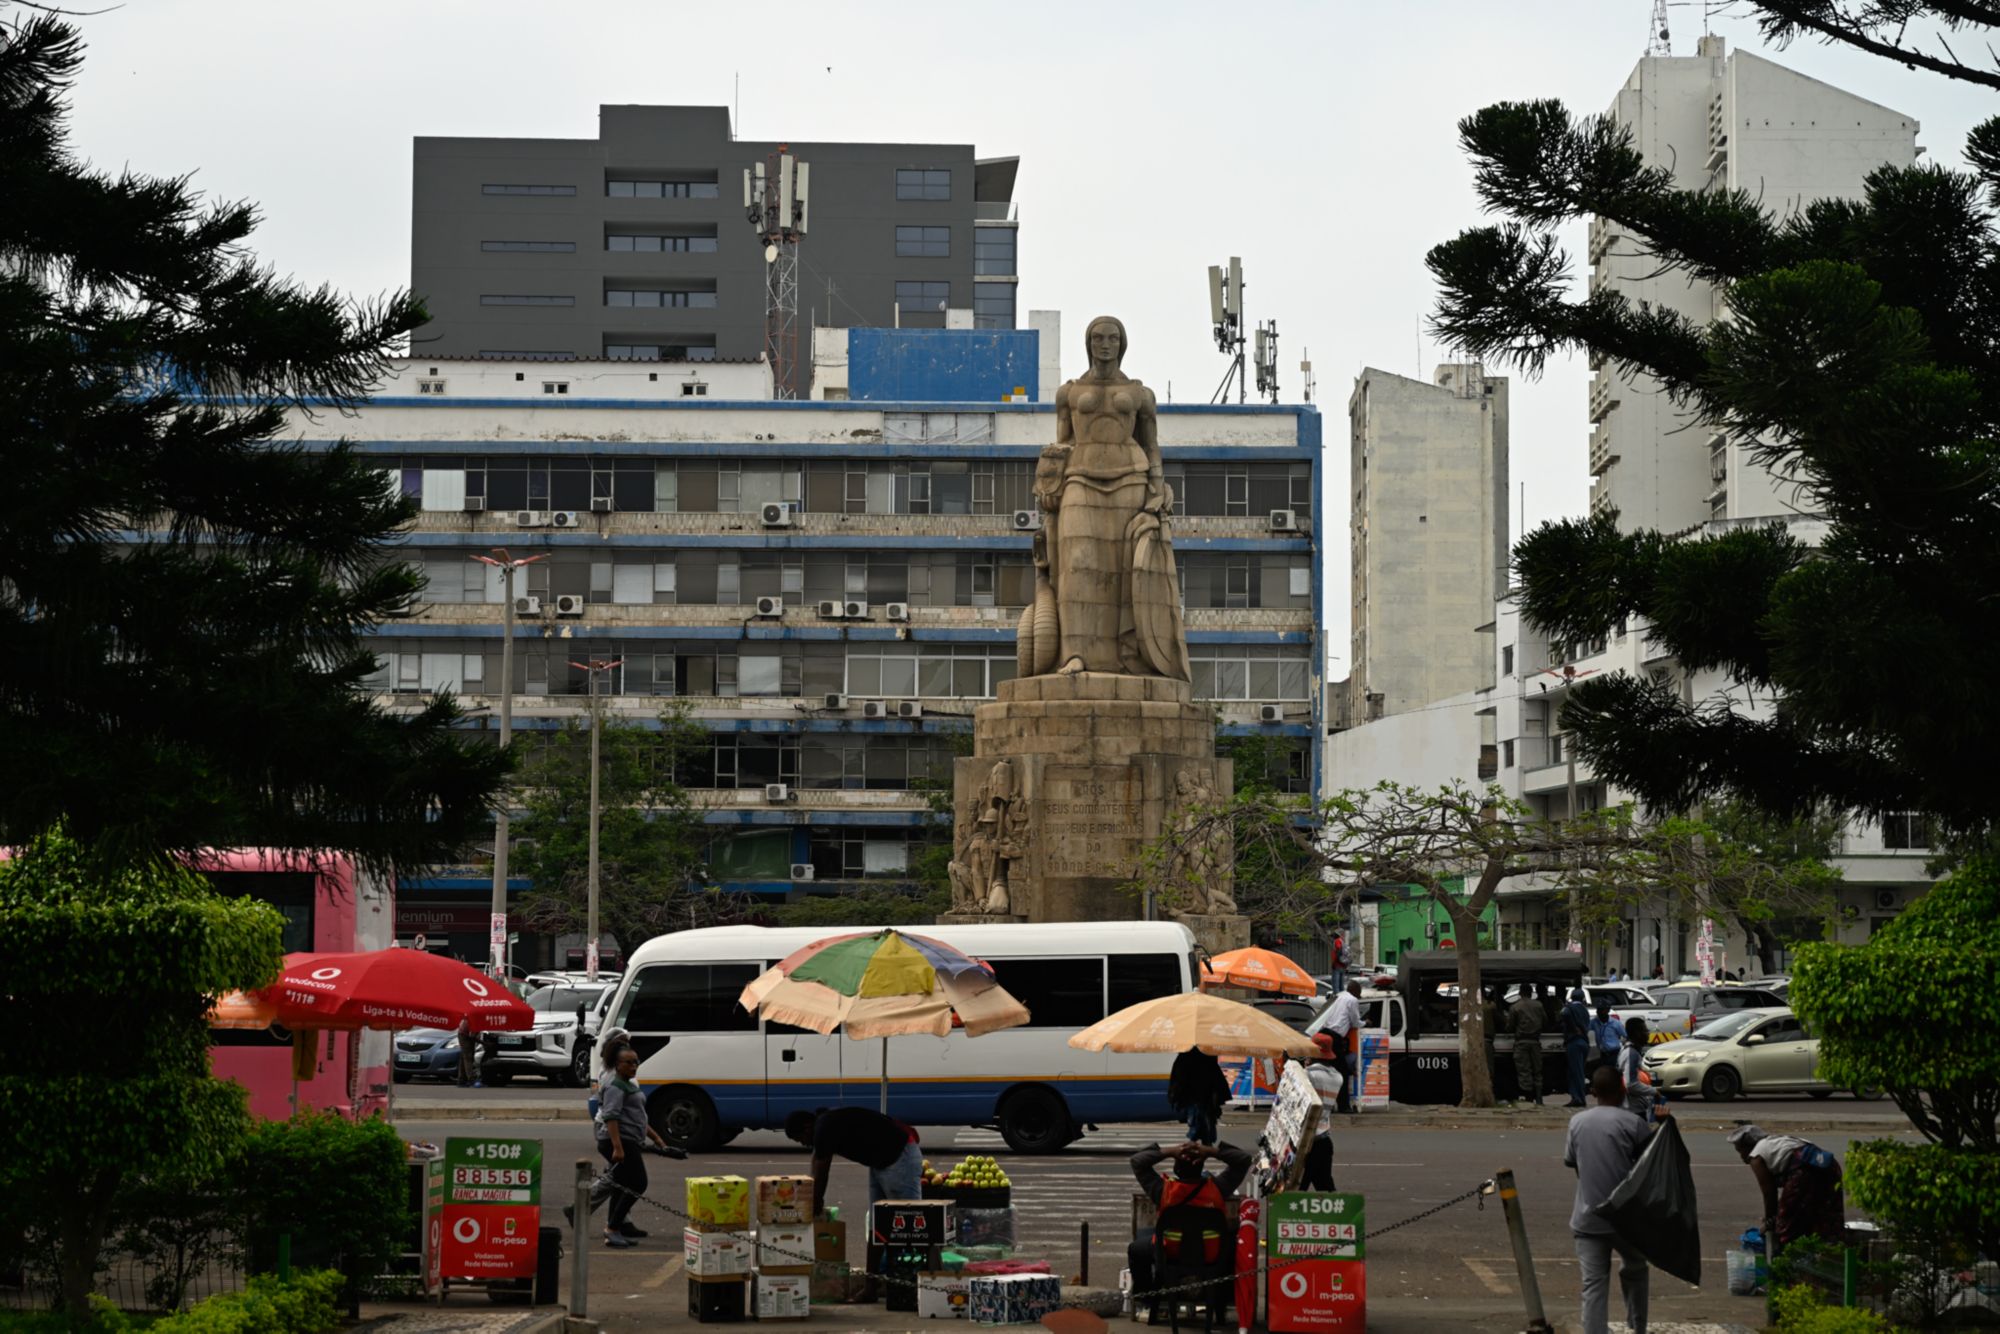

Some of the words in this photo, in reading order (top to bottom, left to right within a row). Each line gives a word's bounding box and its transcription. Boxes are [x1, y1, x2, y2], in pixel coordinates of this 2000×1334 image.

[1047, 804, 1070, 815] SEUS
[1086, 842, 1101, 852] DA
[1047, 861, 1091, 873] GRANDE
[397, 910, 454, 922] lennium
[284, 976, 337, 991] vodacom
[469, 998, 512, 1008] vodacom
[363, 1004, 396, 1018] Liga-te
[405, 1010, 449, 1025] Vodacom
[1417, 1057, 1449, 1069] 0108
[456, 1170, 528, 1184] 88556
[1280, 1224, 1354, 1238] 59584
[492, 1236, 527, 1245] m-pesa
[464, 1260, 480, 1268] Rede
[481, 1260, 508, 1268] Número
[1319, 1293, 1354, 1301] m-pesa
[1293, 1315, 1310, 1323] Rede
[1310, 1315, 1337, 1323] Número
